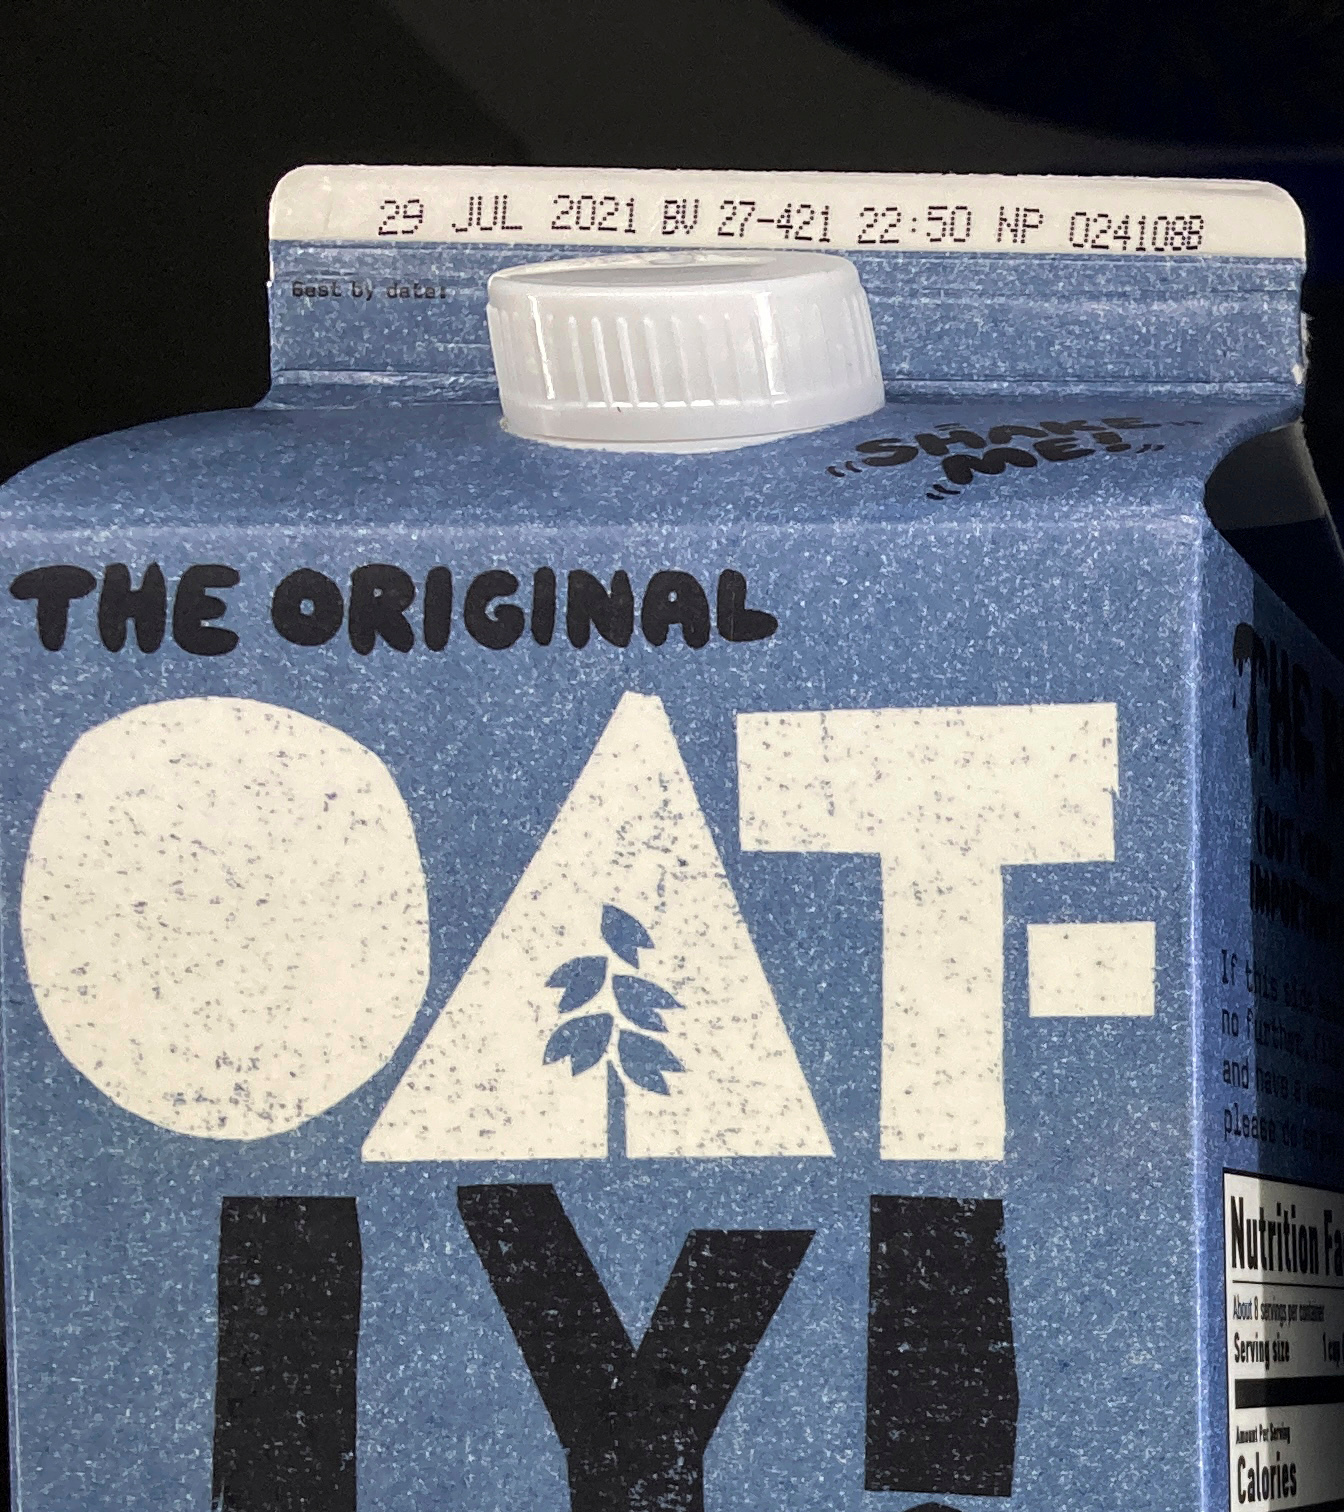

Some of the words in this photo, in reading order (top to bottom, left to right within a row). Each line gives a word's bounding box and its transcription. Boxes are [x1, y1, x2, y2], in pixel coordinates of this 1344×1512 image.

[378, 199, 424, 235] 29
[452, 195, 522, 232] JUL
[552, 195, 636, 234] 2021
[662, 199, 698, 235] BV
[718, 201, 831, 243] 27-421
[858, 206, 972, 244] 22:50
[997, 206, 1043, 243] NP
[352, 281, 371, 300] by
[9, 562, 239, 656] THE
[270, 564, 778, 656] ORIGINAL
[20, 691, 1155, 1163] OAT-
[1231, 1195, 1319, 1274] Nutrition
[1234, 1332, 1270, 1369] Serving
[1272, 1332, 1290, 1362] size
[1238, 1451, 1297, 1504] Calories
